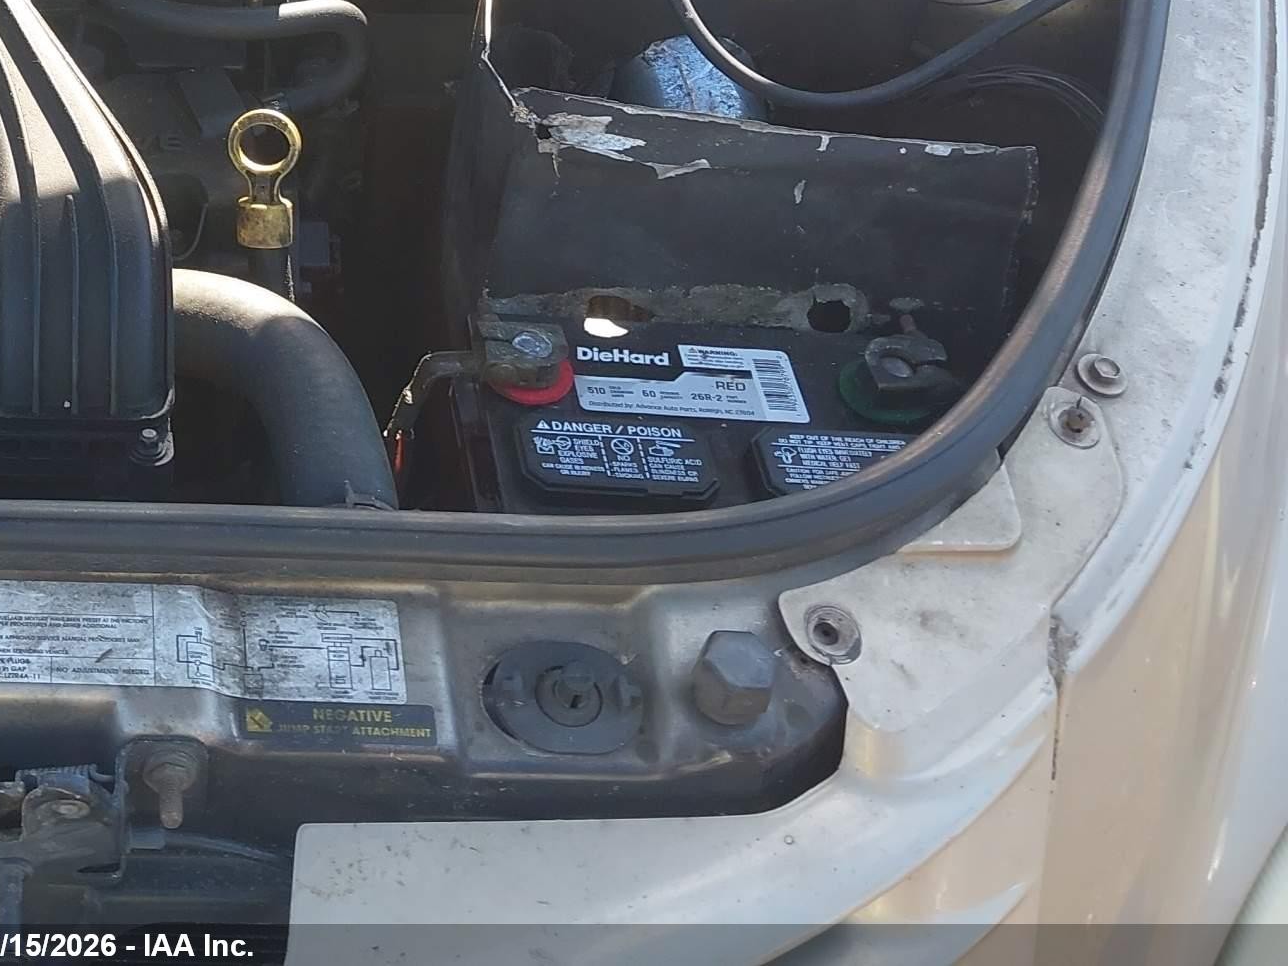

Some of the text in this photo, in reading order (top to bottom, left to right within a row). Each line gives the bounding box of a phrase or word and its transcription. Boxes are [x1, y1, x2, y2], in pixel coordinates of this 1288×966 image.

[576, 346, 670, 367] DieHard
[586, 386, 606, 395] 510
[642, 390, 656, 398] 60
[690, 393, 723, 402] 26R-2
[715, 381, 746, 392] RED
[589, 400, 623, 409] Distributed
[552, 421, 612, 433] DANGER
[628, 425, 683, 438] POISON
[313, 708, 392, 723] NEGATIVE
[352, 726, 432, 738] ATTACHMENT
